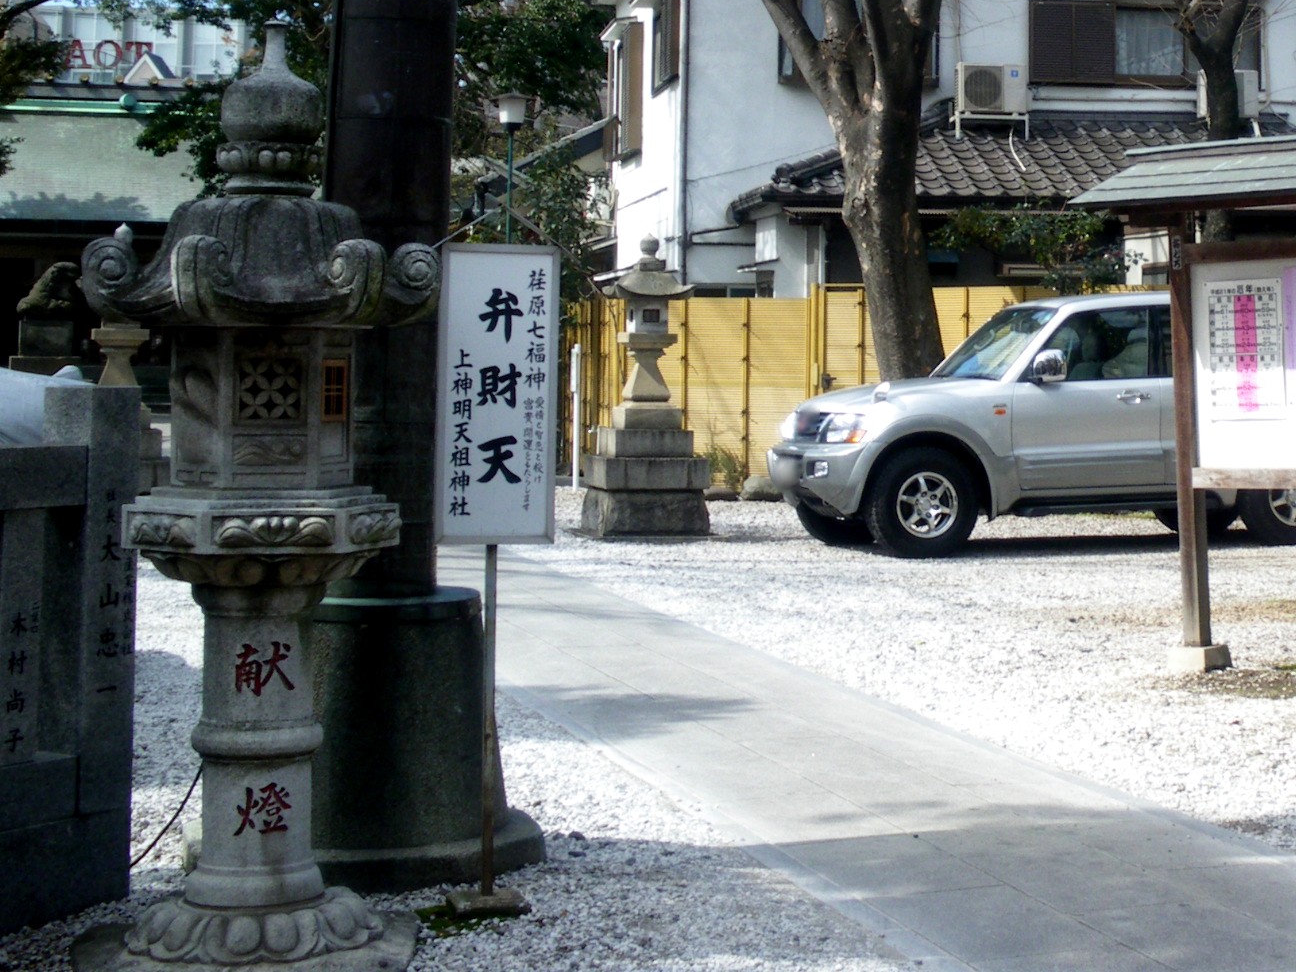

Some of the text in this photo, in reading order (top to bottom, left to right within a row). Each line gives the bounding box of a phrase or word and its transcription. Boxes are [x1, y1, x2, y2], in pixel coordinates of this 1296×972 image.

[476, 288, 524, 484] 弁財天
[524, 268, 547, 390] 荏原七福神
[448, 349, 473, 516] 上神明天祖神社
[97, 534, 120, 693] 大山忠一
[233, 641, 296, 837] 献燈
